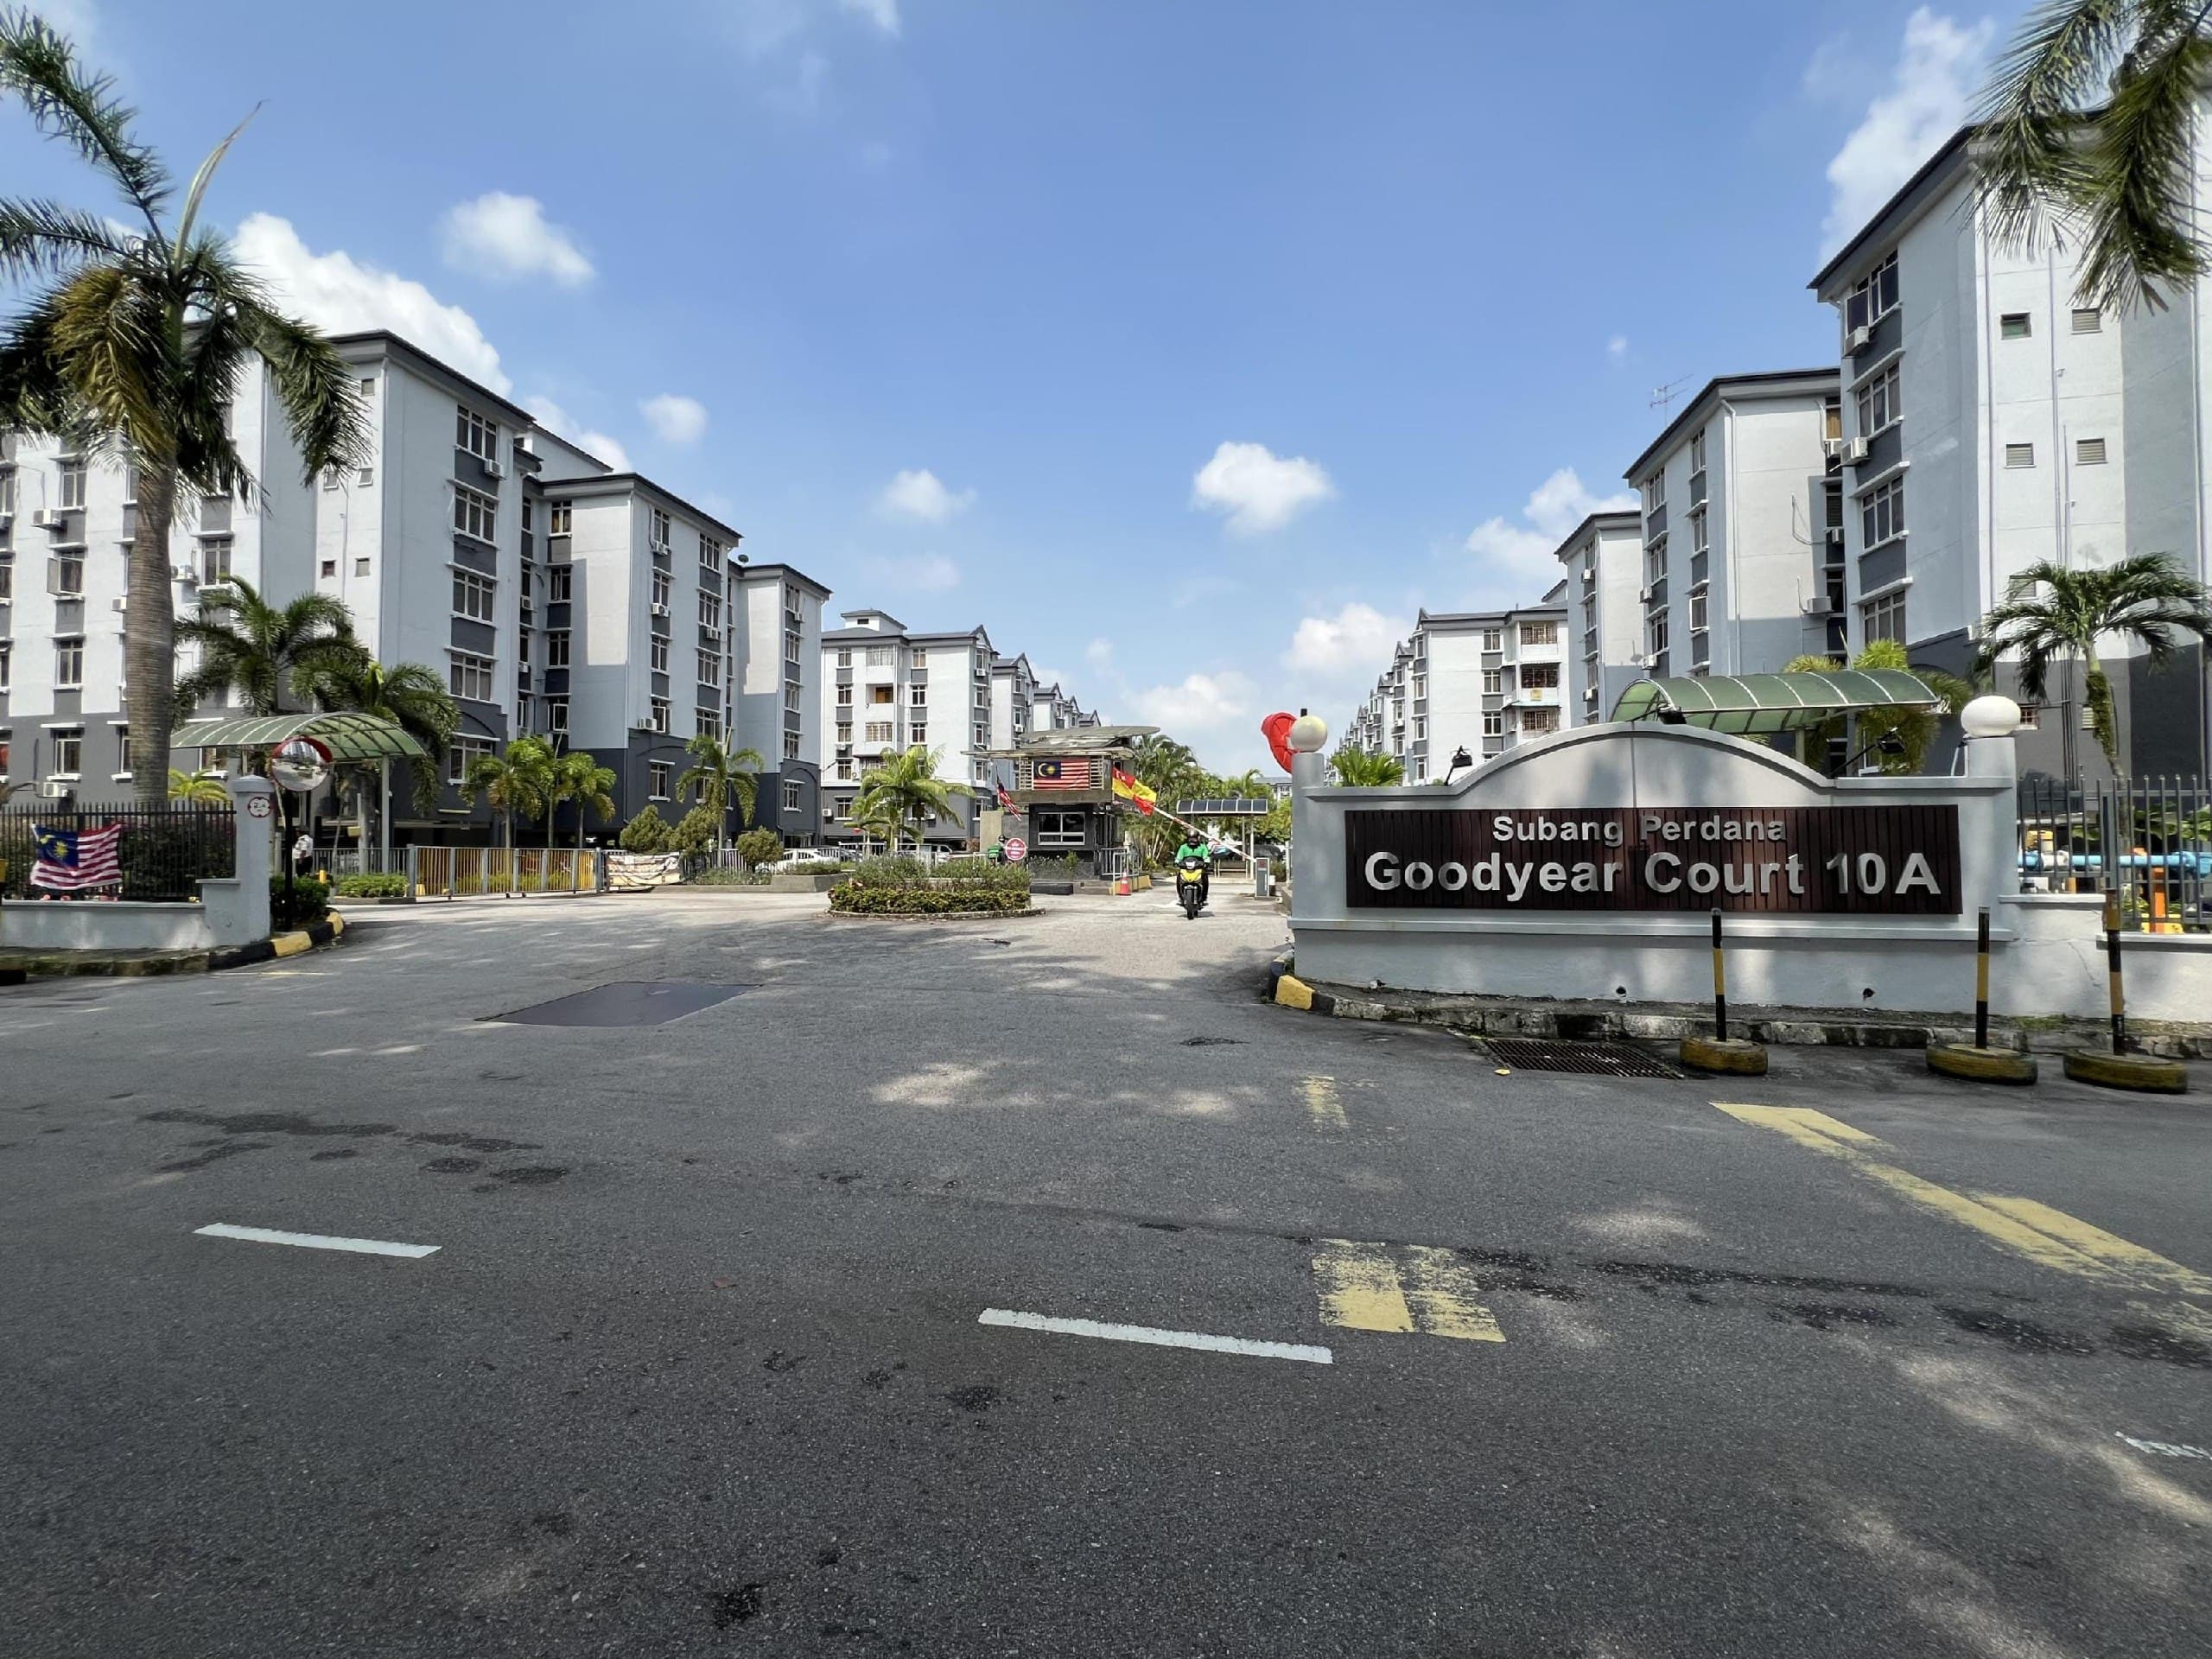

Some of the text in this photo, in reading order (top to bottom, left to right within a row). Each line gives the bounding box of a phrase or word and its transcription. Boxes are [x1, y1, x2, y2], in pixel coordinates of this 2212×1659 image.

[1493, 815, 1786, 847] Subang Perdana
[1364, 851, 1942, 902] Goodyear Court 10A
